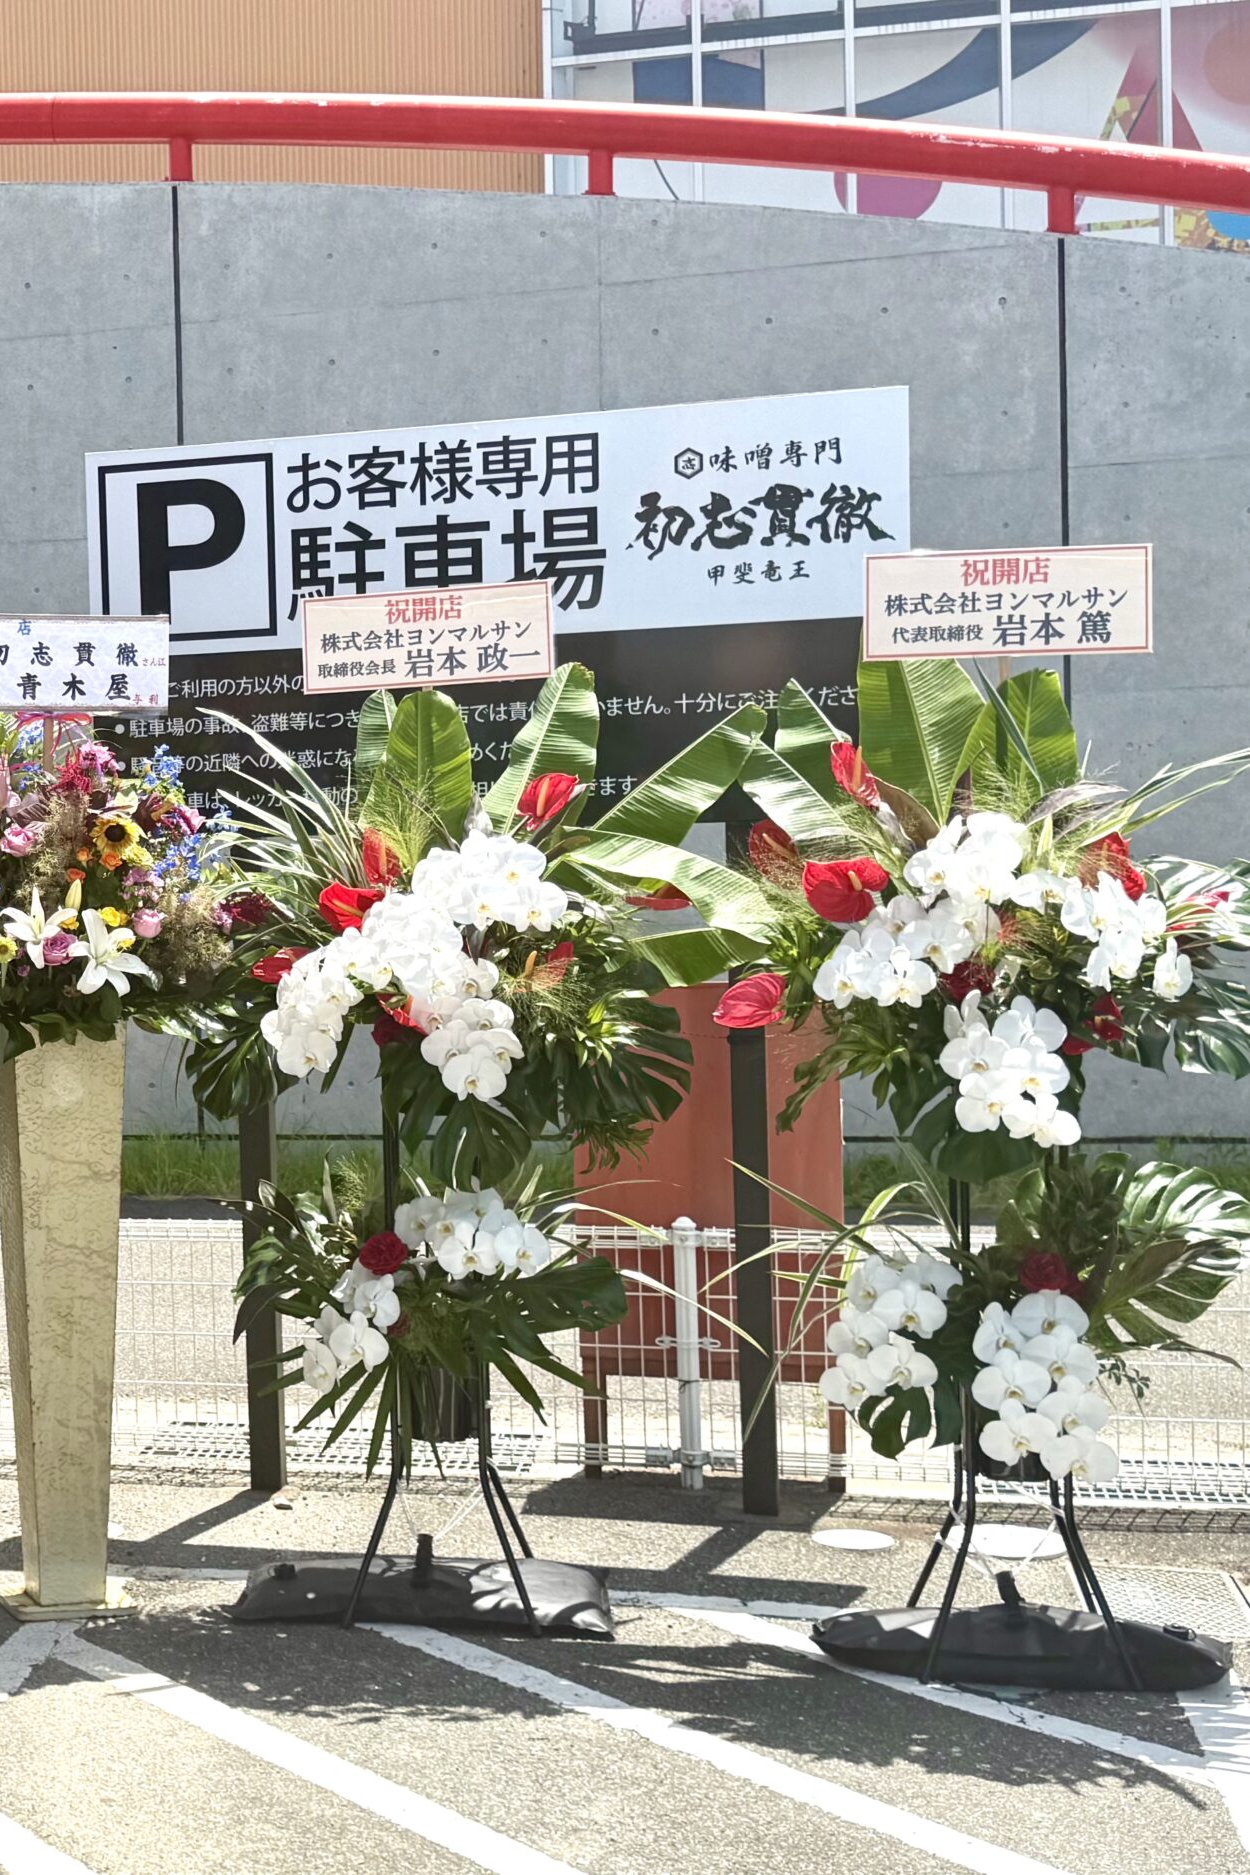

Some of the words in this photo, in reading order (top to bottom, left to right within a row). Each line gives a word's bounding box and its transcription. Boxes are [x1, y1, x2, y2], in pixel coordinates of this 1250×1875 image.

[709, 437, 843, 473] 味噌専門
[286, 432, 600, 514] お客様専用
[625, 482, 896, 560] 初志貫徹
[136, 478, 246, 626] P
[287, 506, 607, 622] 駐車場
[707, 560, 810, 586] 甲斐竜王
[960, 556, 1051, 586] 祝開店
[384, 595, 464, 625] 祝開店
[884, 586, 1128, 617] 株式会社ヨンマルサン
[320, 620, 533, 654] 株式会社ヨンマルサン
